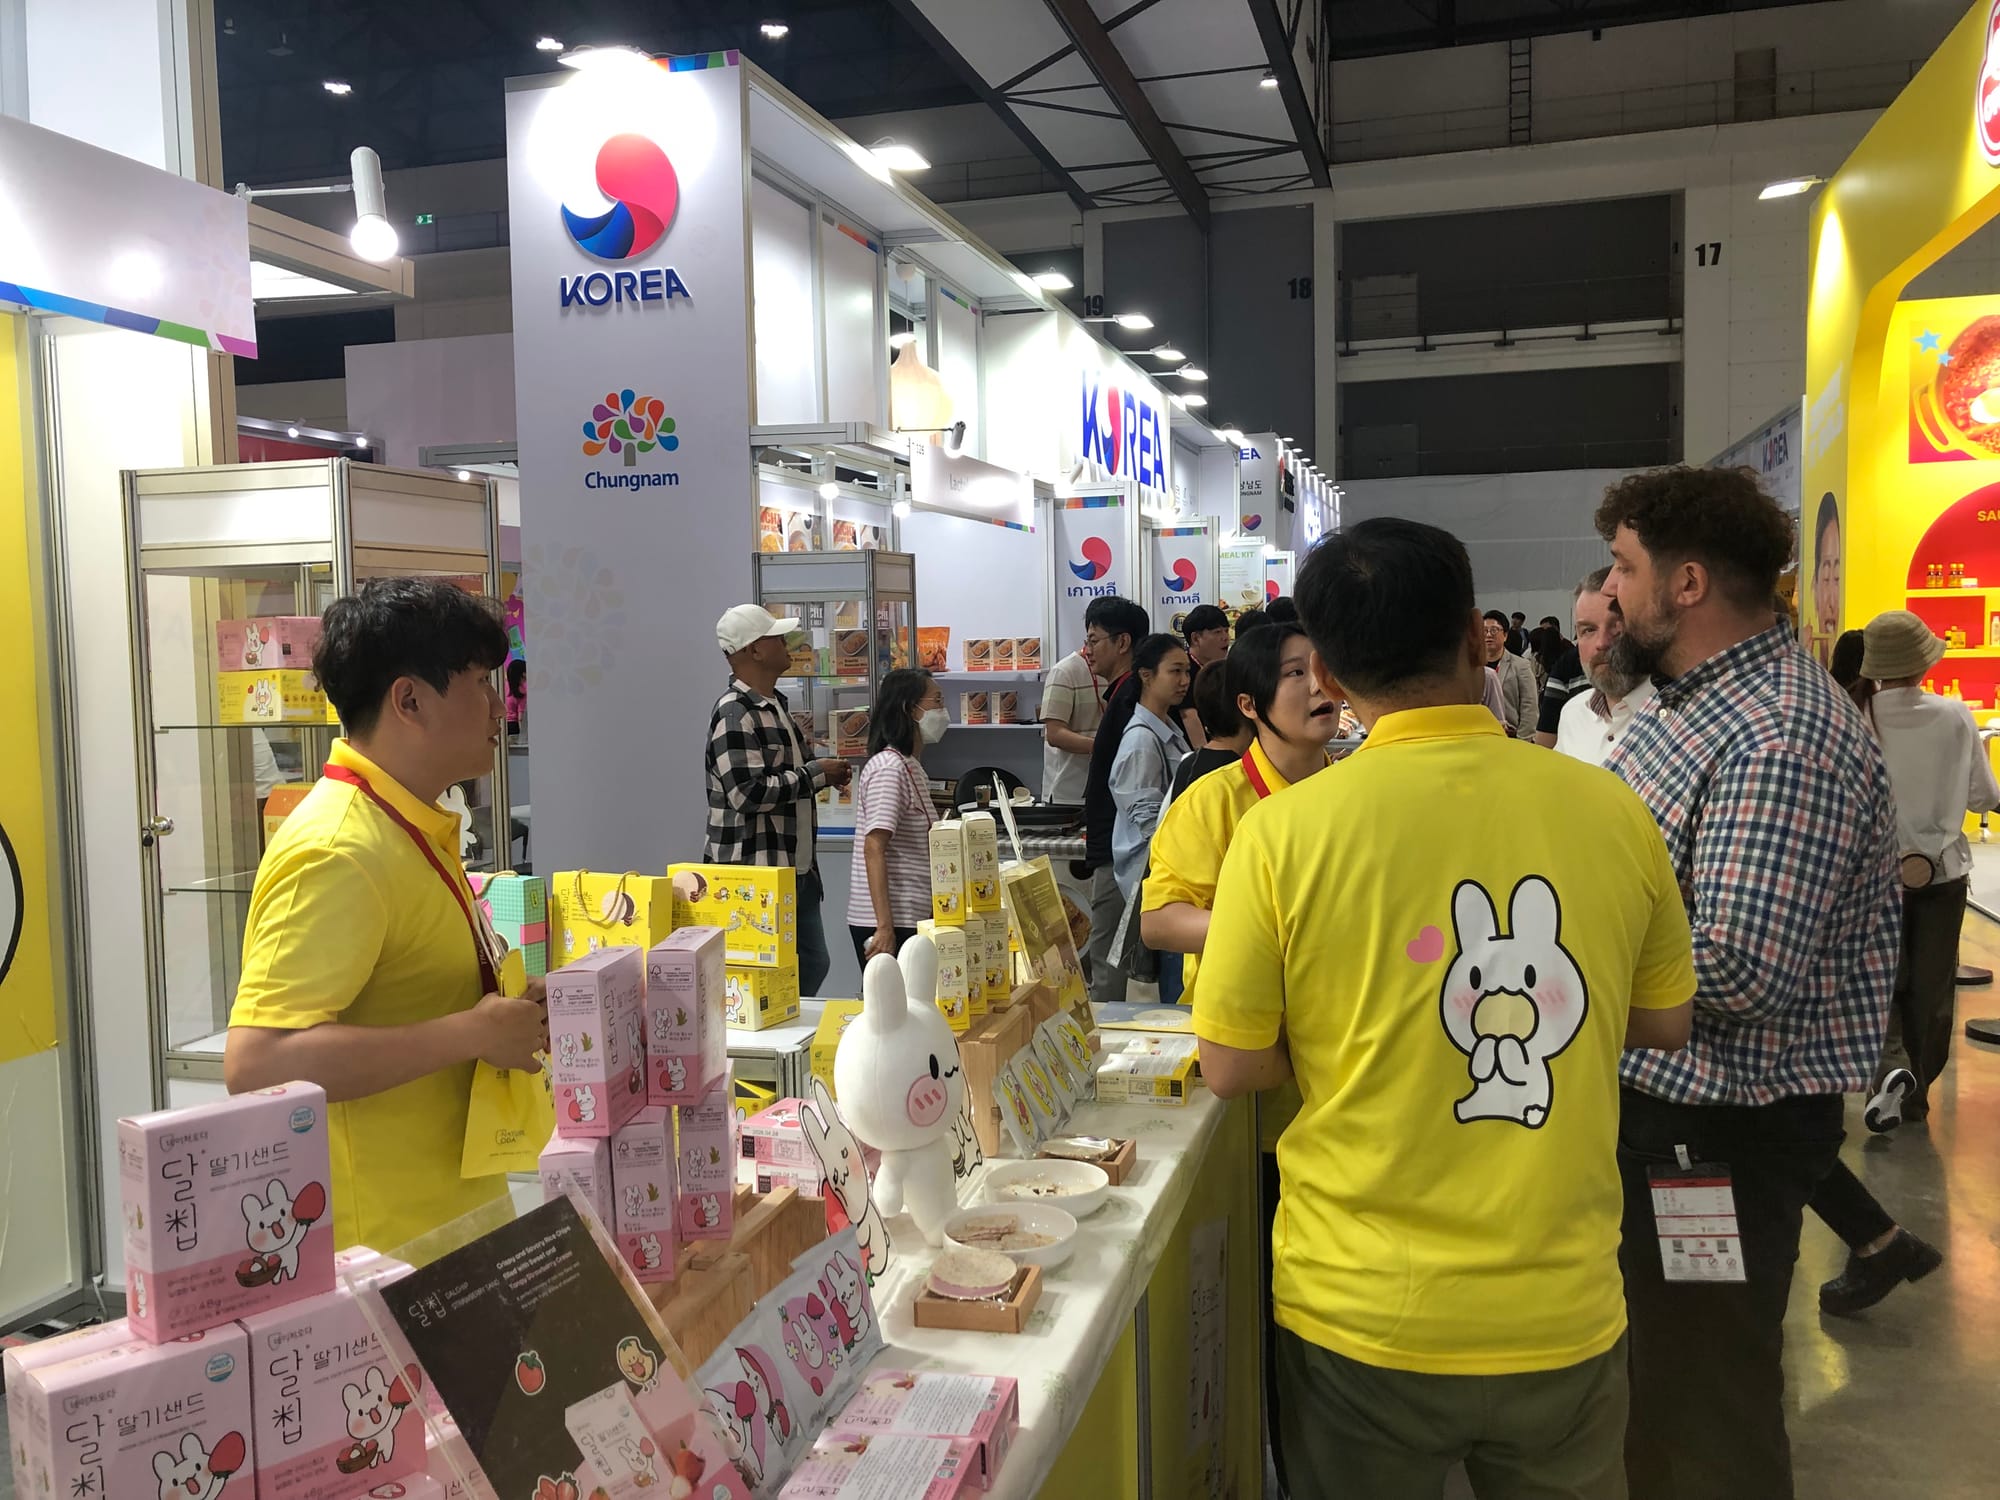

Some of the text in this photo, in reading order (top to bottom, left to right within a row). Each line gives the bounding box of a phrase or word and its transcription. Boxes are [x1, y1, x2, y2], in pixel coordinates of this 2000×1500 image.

[1695, 243, 1722, 267] 17
[560, 267, 691, 308] KOREA
[1287, 277, 1312, 300] 18
[1084, 294, 1104, 316] 19
[584, 471, 679, 492] Chungnam
[1067, 581, 1117, 597] เกาหลี
[209, 1141, 290, 1178] 딸기샌드
[117, 1392, 206, 1437] 딸기샌드
